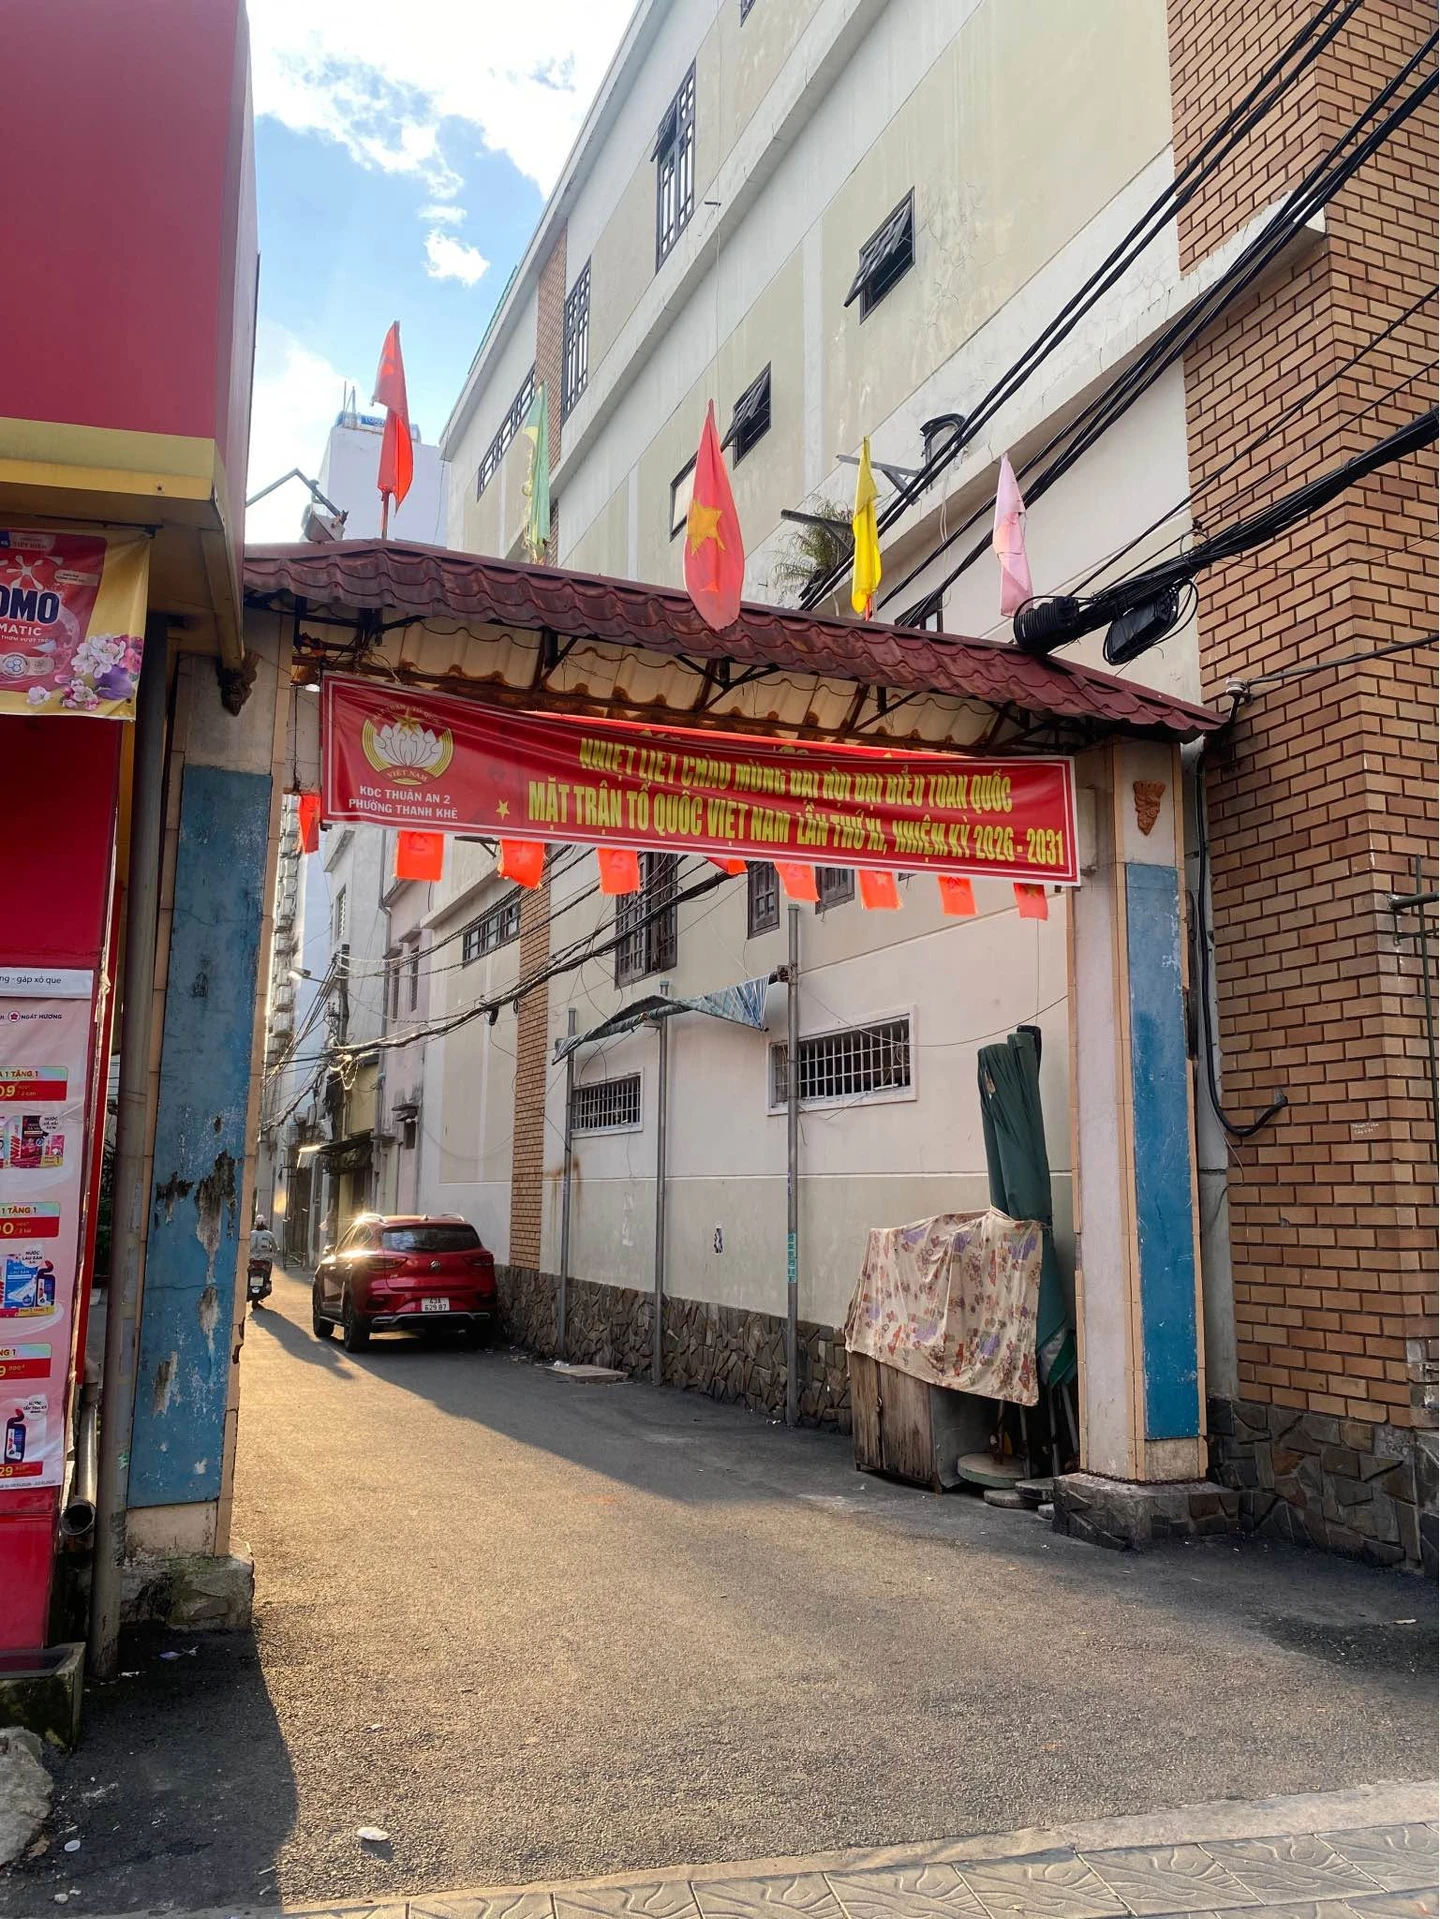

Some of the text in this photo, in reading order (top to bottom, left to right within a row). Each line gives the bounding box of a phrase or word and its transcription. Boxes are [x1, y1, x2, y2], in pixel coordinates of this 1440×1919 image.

[348, 797, 392, 813] PHƯỜNG
[395, 804, 432, 817] THANH
[359, 785, 451, 804] KDC THUẬN AN 2
[970, 769, 1013, 814] QUỐC
[528, 774, 569, 831] MẶT
[573, 780, 622, 836] TRẬN
[626, 780, 651, 831] TỔ
[653, 788, 703, 837] QUỐC
[707, 796, 749, 847] VIỆT
[750, 806, 791, 844] NAM
[892, 814, 948, 863] NHIỆM
[948, 815, 970, 859] KỲ
[973, 825, 1016, 862] 2026
[1026, 827, 1065, 866] 2031
